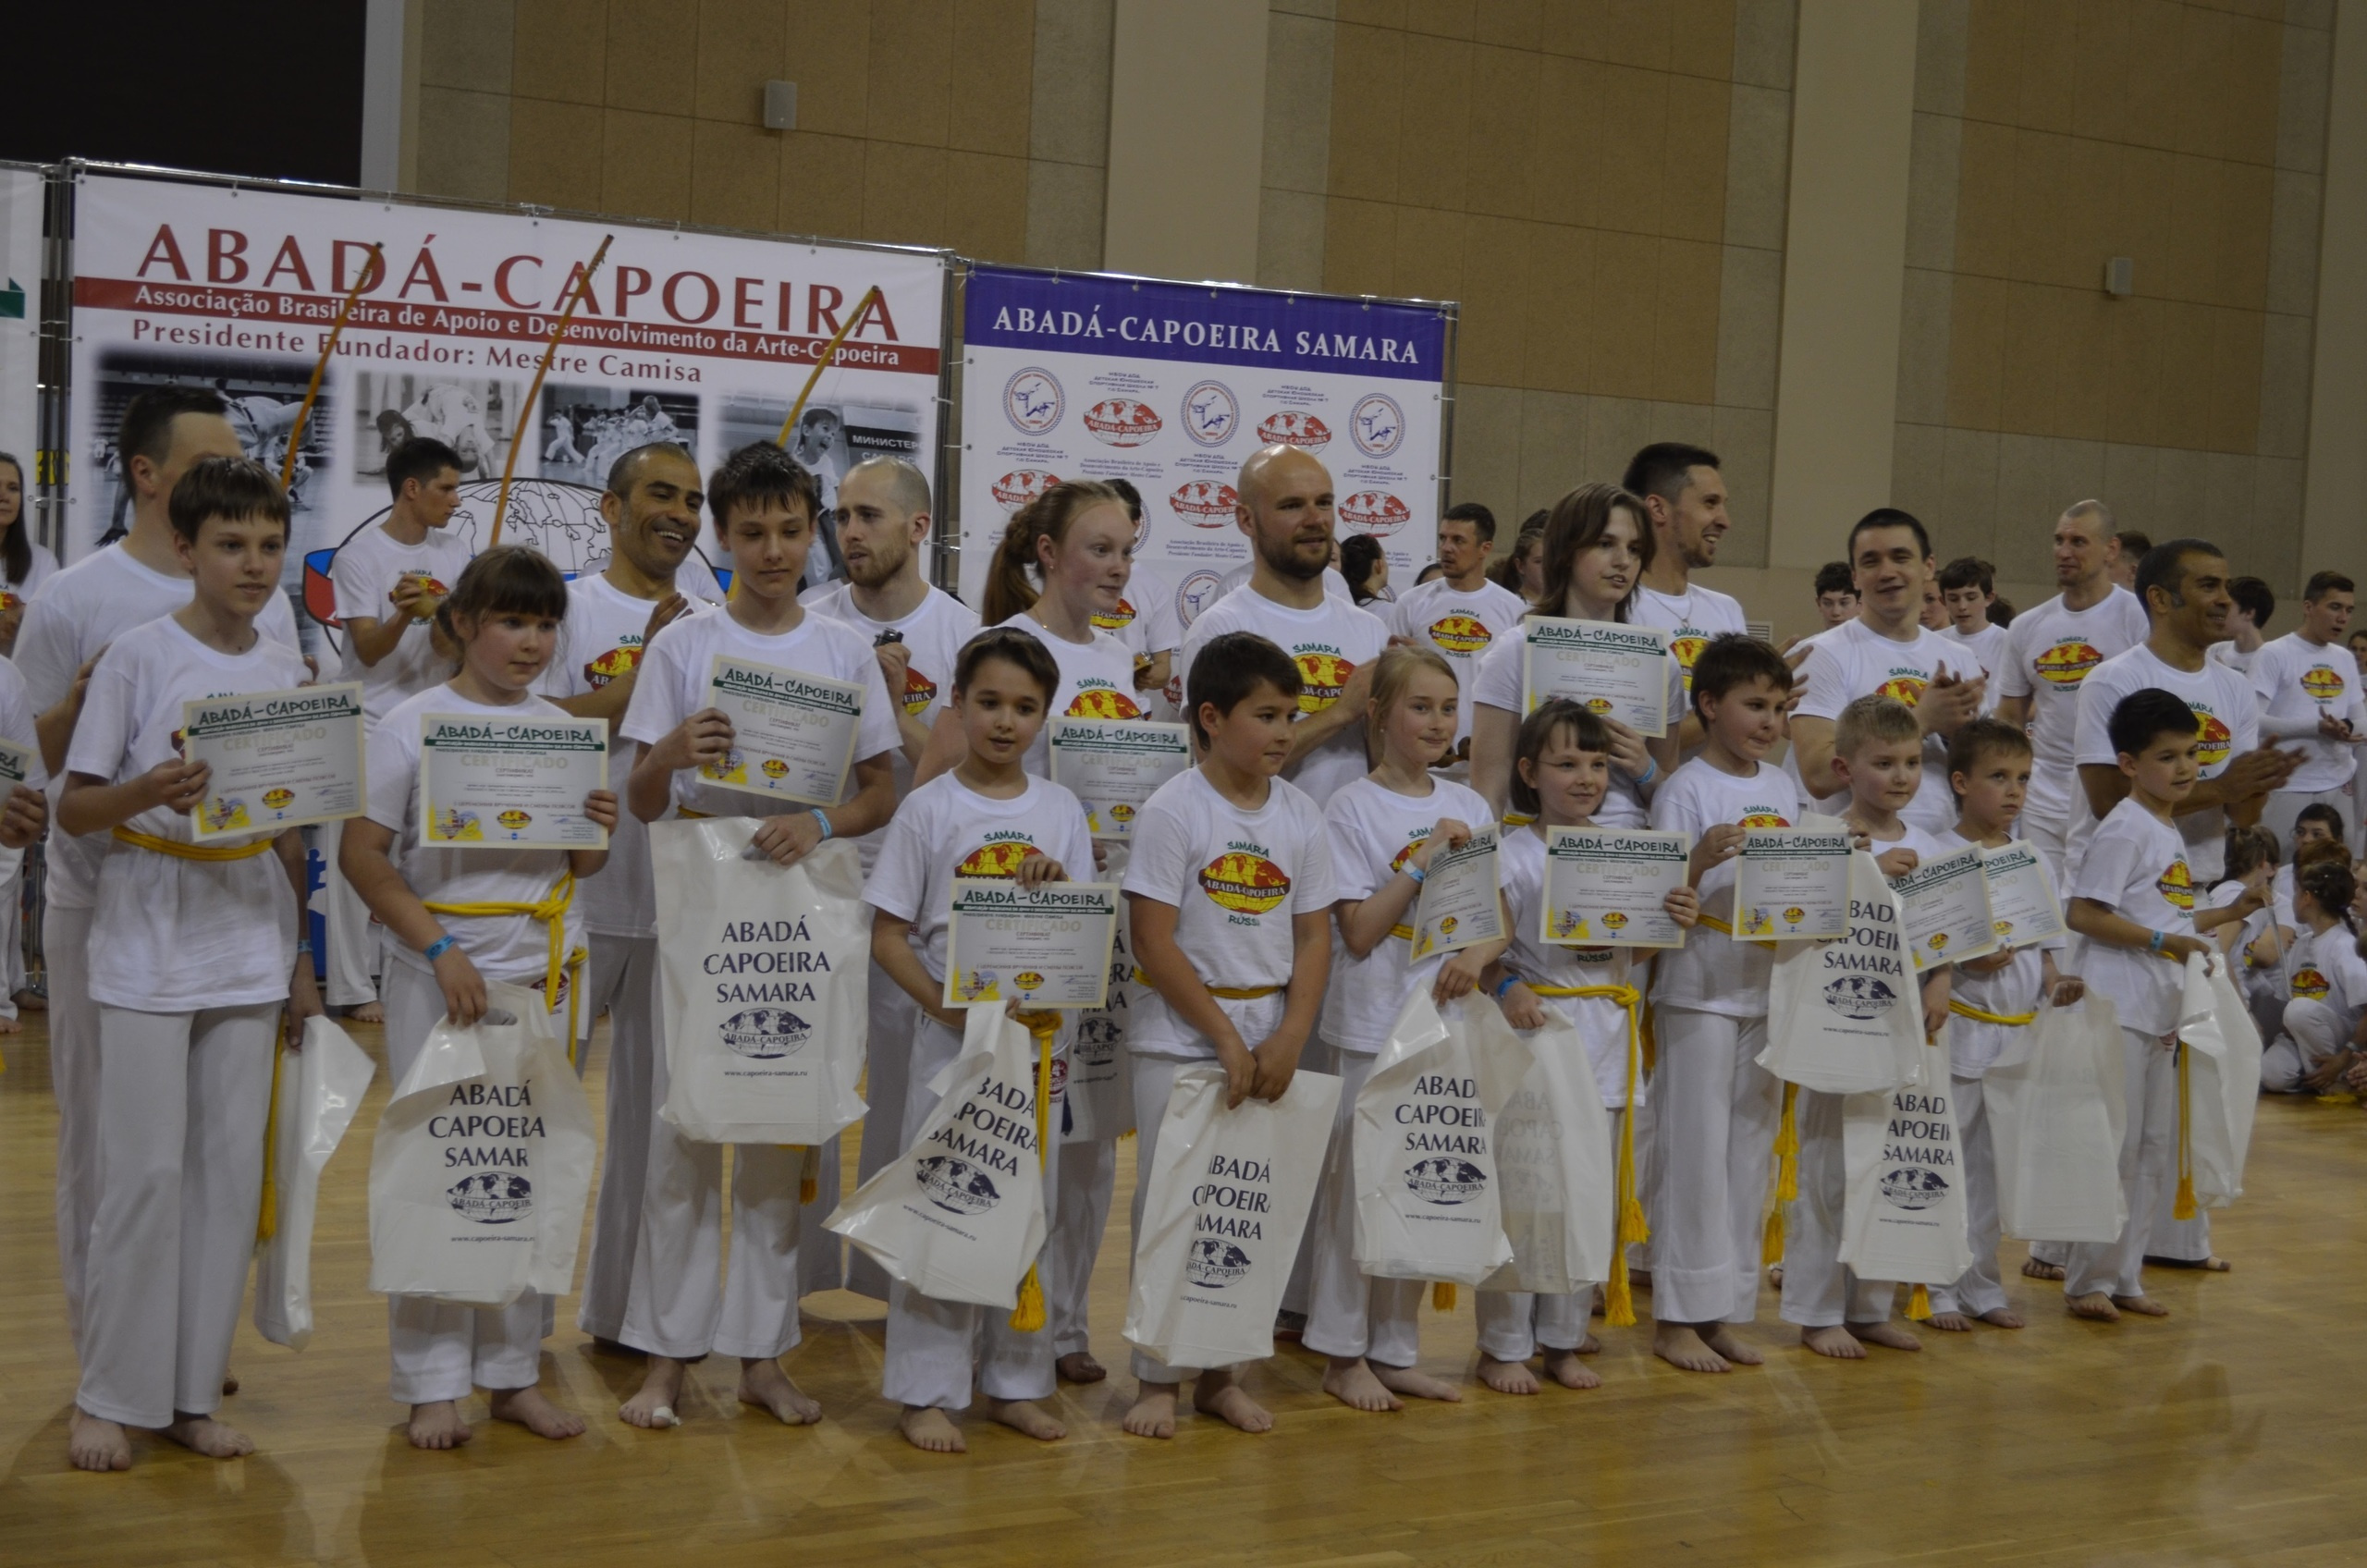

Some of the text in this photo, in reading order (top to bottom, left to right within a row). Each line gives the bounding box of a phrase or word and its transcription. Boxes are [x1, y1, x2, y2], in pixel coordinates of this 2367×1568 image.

[136, 224, 899, 341] ABADÁ-CAPOEIRA
[135, 285, 900, 369] Associação Brasileira de Apoio e Desenvolvimento da Arte-Capoeira
[992, 303, 1419, 364] ABADÁ-CAPOEIRA SAMARA
[133, 319, 703, 384] Presidente Fundador: Mestre Camisa
[1450, 608, 1480, 619] SAMARA
[1537, 625, 1659, 648] ABADÁ-CAPOEIRA
[1293, 643, 1342, 655] SAMARA
[1076, 677, 1117, 690] SAMARA
[1889, 668, 1929, 680] SAMARA
[725, 668, 852, 706] ABADÁ-CAPOEIRA
[199, 695, 350, 725] ABADÁ-CAPOEIRA
[436, 722, 594, 742] ABADÁ-CAPOEIRA
[1061, 726, 1179, 745] ABADÁ-CAPOEIRA
[1743, 804, 1780, 815] SAMARA
[984, 830, 1034, 843] SAMARA
[1558, 834, 1680, 853] ABADÁ-CAPOEIRA
[1747, 834, 1846, 849] ABADÁ-CAPOEIRA
[1227, 840, 1269, 858] SAMARA
[963, 888, 1105, 906] ABADÁ-CAPOEIRA
[721, 914, 811, 943] ABADÁ
[703, 950, 831, 974] CAPOEIRA
[1824, 951, 1903, 976] SAMARA
[717, 982, 816, 1004] SAMARA
[723, 1031, 808, 1044] ABADÁ-CAPOEIRA
[1414, 1075, 1480, 1098] ABAD
[1395, 1104, 1487, 1128] CAPOEIR
[1405, 1132, 1487, 1155] SAMARA
[1883, 1144, 1955, 1166] SAMARA
[1407, 1178, 1485, 1191] ABADÁ-CAPOEIRA
